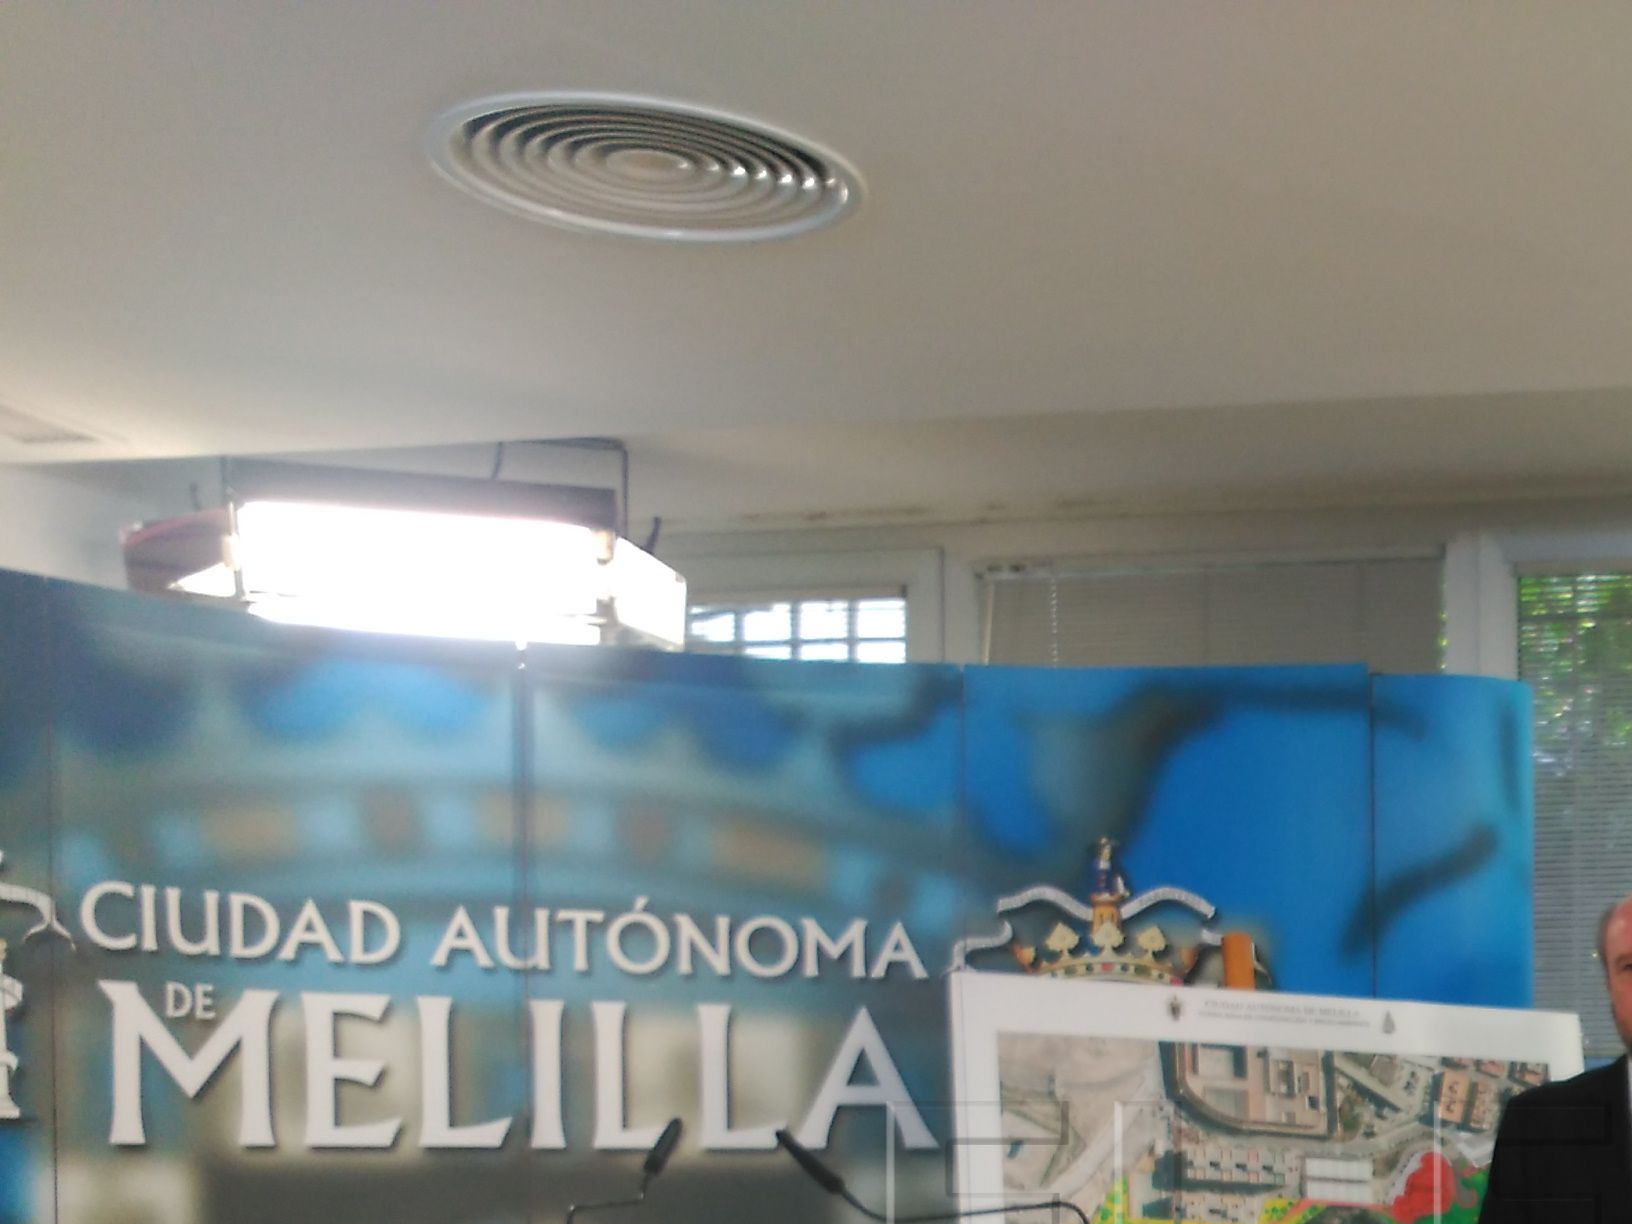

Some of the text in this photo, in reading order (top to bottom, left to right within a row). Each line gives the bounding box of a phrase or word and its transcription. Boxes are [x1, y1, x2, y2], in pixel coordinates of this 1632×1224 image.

[80, 880, 928, 979] CIUDAD AUTÓNOMA
[97, 978, 940, 1150] DE MELILLA
